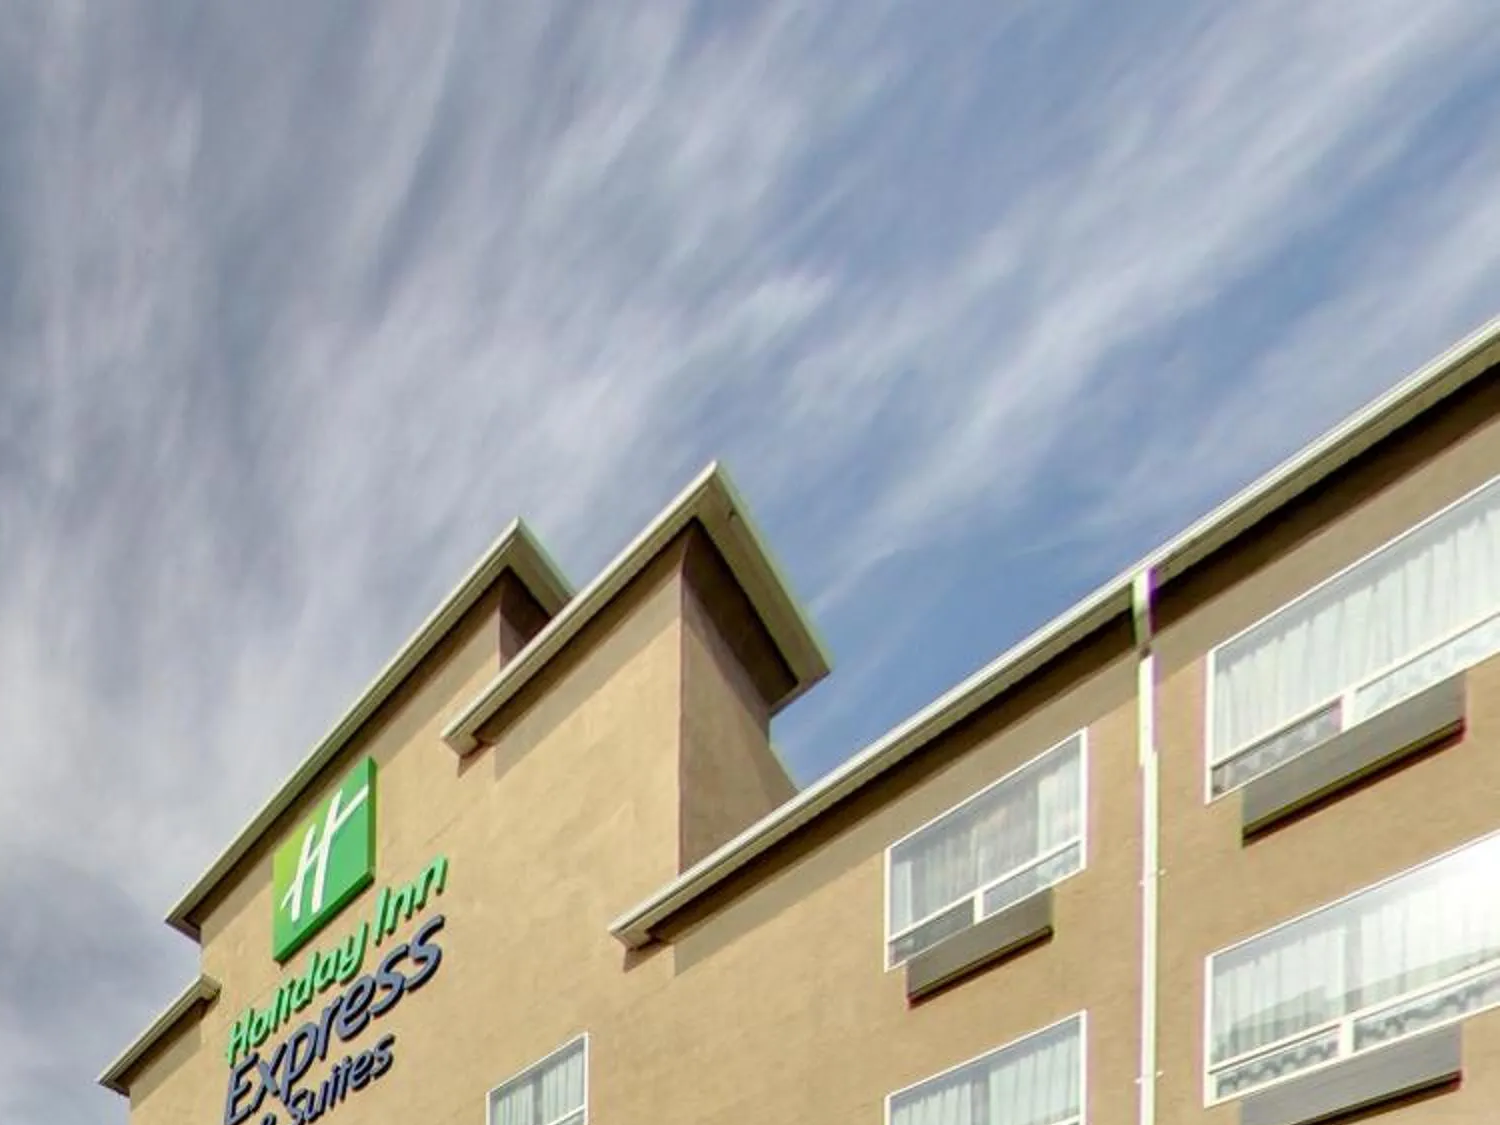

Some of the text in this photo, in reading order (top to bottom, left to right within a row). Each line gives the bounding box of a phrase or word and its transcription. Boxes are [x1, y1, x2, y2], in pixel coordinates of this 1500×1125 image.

[281, 784, 369, 923] H
[226, 854, 448, 1064] Holiday Inn
